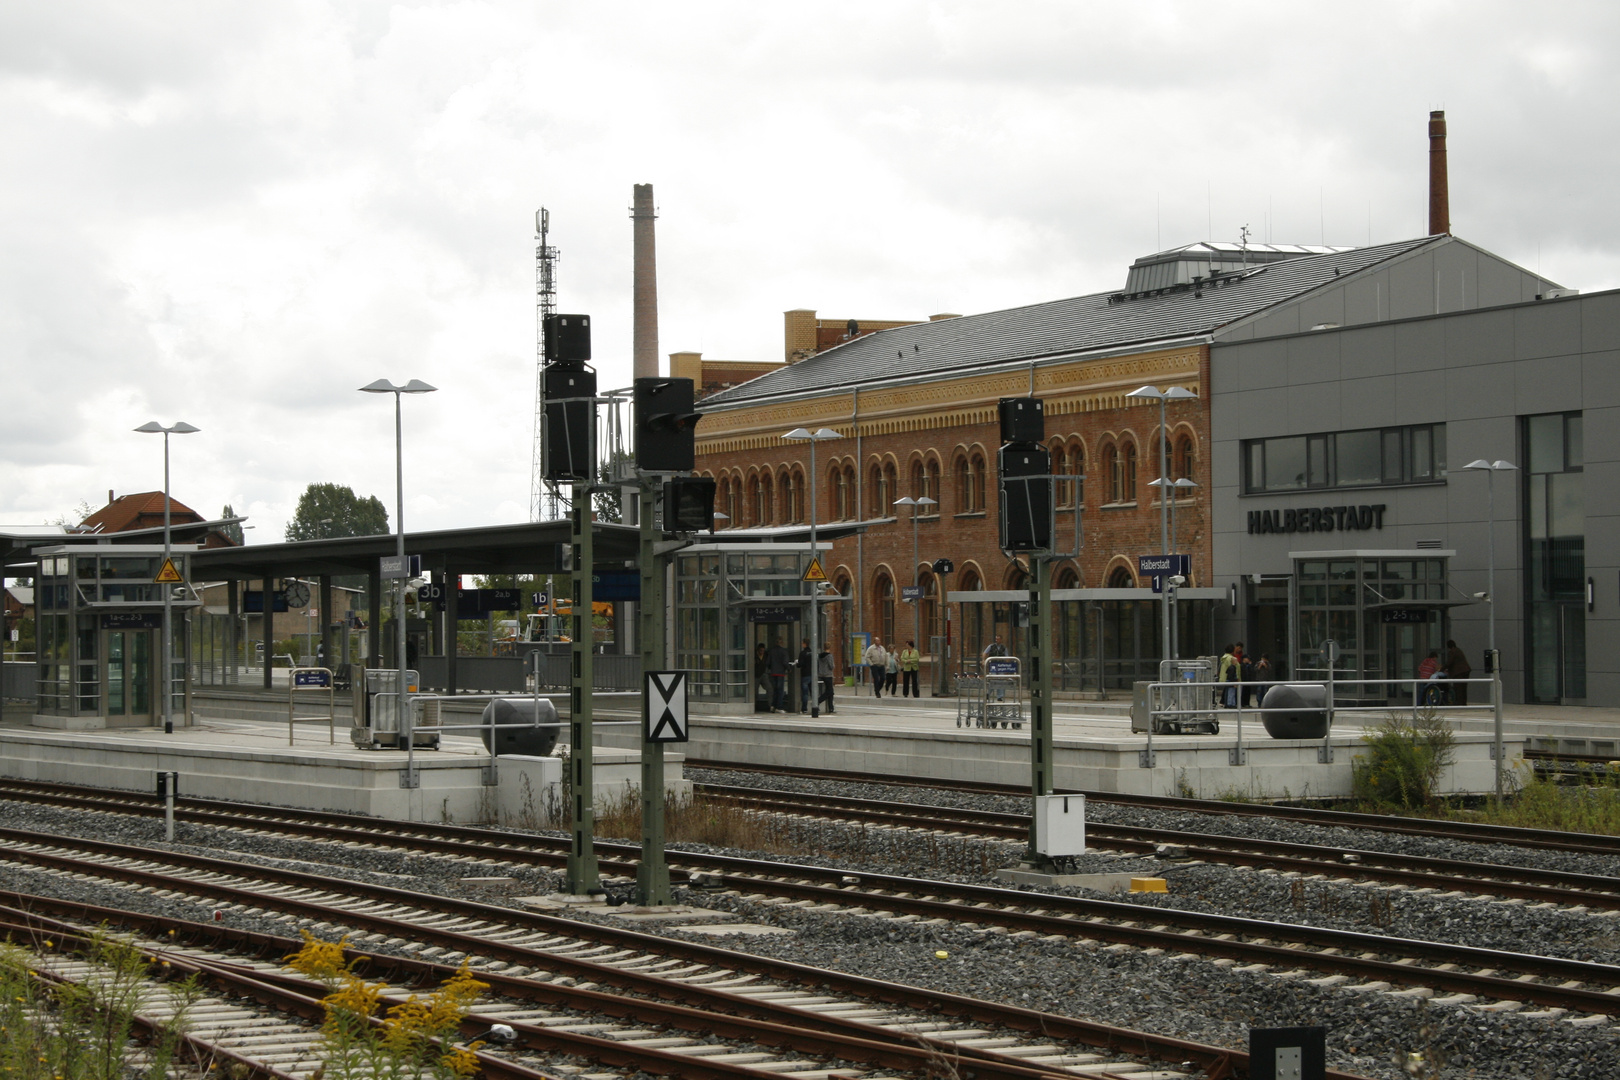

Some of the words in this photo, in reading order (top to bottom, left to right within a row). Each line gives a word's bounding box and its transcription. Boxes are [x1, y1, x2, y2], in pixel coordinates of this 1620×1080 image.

[1247, 504, 1386, 534] HALBERSTADT
[1141, 559, 1170, 570] Halberstadt
[1153, 575, 1159, 589] 1
[421, 584, 440, 598] 3b
[495, 591, 510, 599] 2a,b
[533, 593, 546, 603] 1b
[1393, 610, 1407, 619] 2-5
